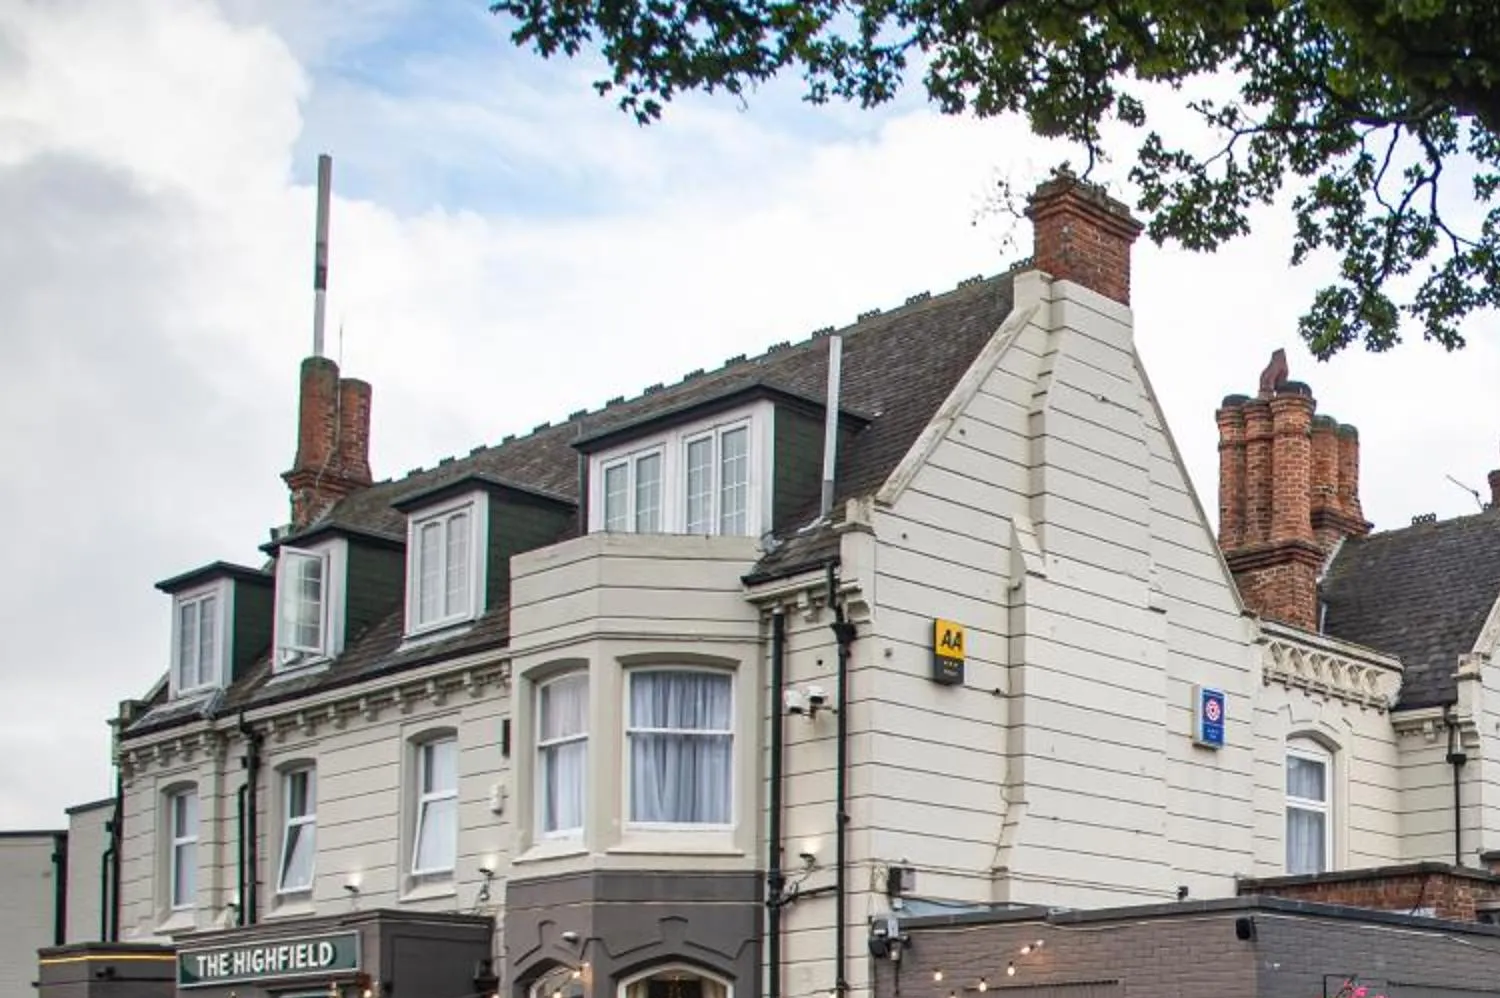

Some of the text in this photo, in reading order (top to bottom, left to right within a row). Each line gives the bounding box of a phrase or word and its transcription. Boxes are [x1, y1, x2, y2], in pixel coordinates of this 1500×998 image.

[940, 629, 962, 651] AA
[196, 941, 335, 977] THE HIGHFIELD
